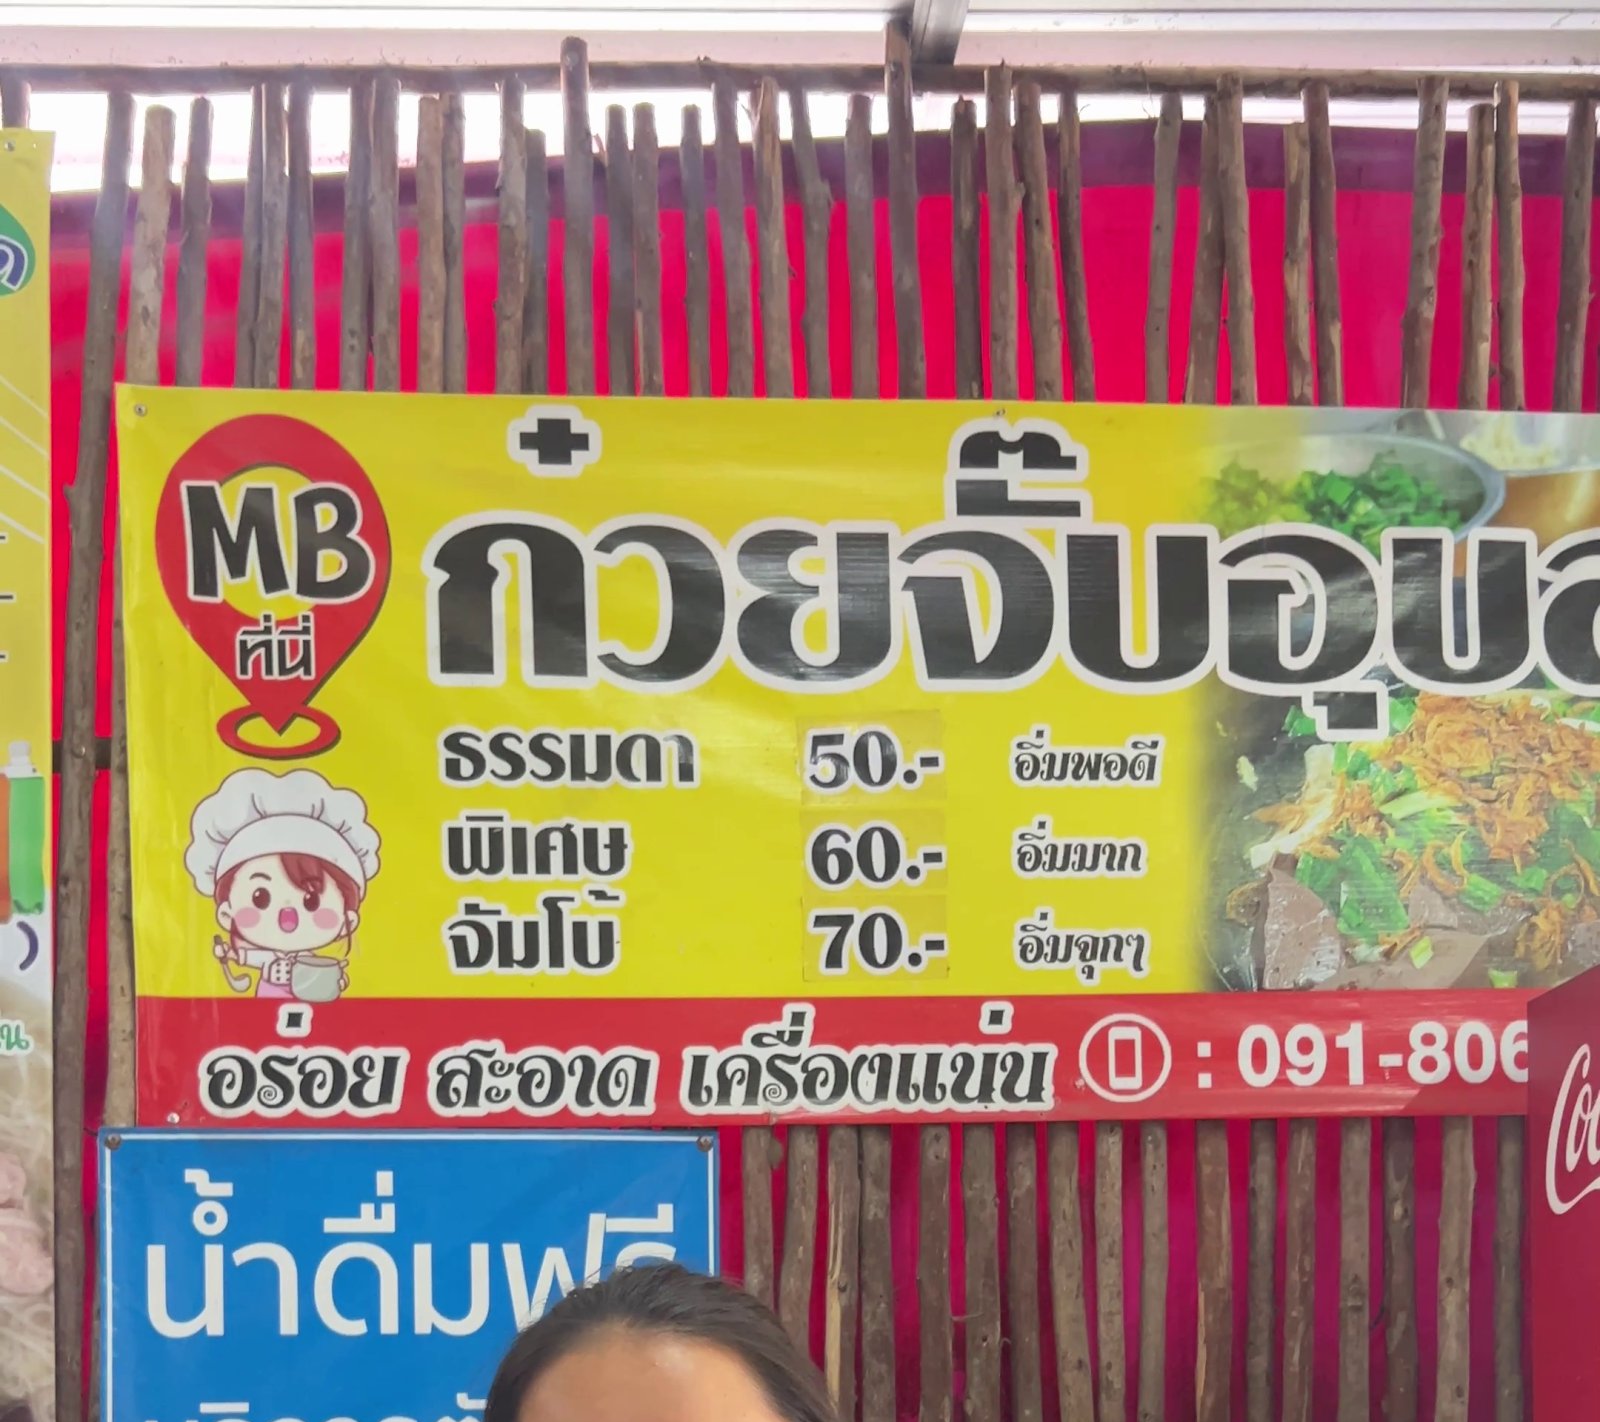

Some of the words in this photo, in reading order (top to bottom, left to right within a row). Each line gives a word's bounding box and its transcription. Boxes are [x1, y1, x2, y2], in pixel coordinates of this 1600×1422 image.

[180, 482, 373, 603] MB
[236, 613, 314, 680] ที่นี่
[442, 730, 697, 784] ธรรมดา
[806, 730, 941, 788] 50.-
[1012, 727, 1161, 783] อิ่มพอดี
[445, 814, 628, 877] พิเศษ
[810, 826, 945, 885] 60.-
[1015, 818, 1145, 874] อิ่มมาก
[448, 890, 620, 972] จัมโบ้
[812, 910, 947, 971] 70.-
[1016, 911, 1148, 981] อิ่มจุกๆ
[204, 1007, 405, 1116] อร่อย
[432, 1043, 656, 1114] สะอาด
[684, 1003, 1055, 1110] เครื่องแน่น
[147, 1168, 678, 1338] น้ำดื่มฟี
